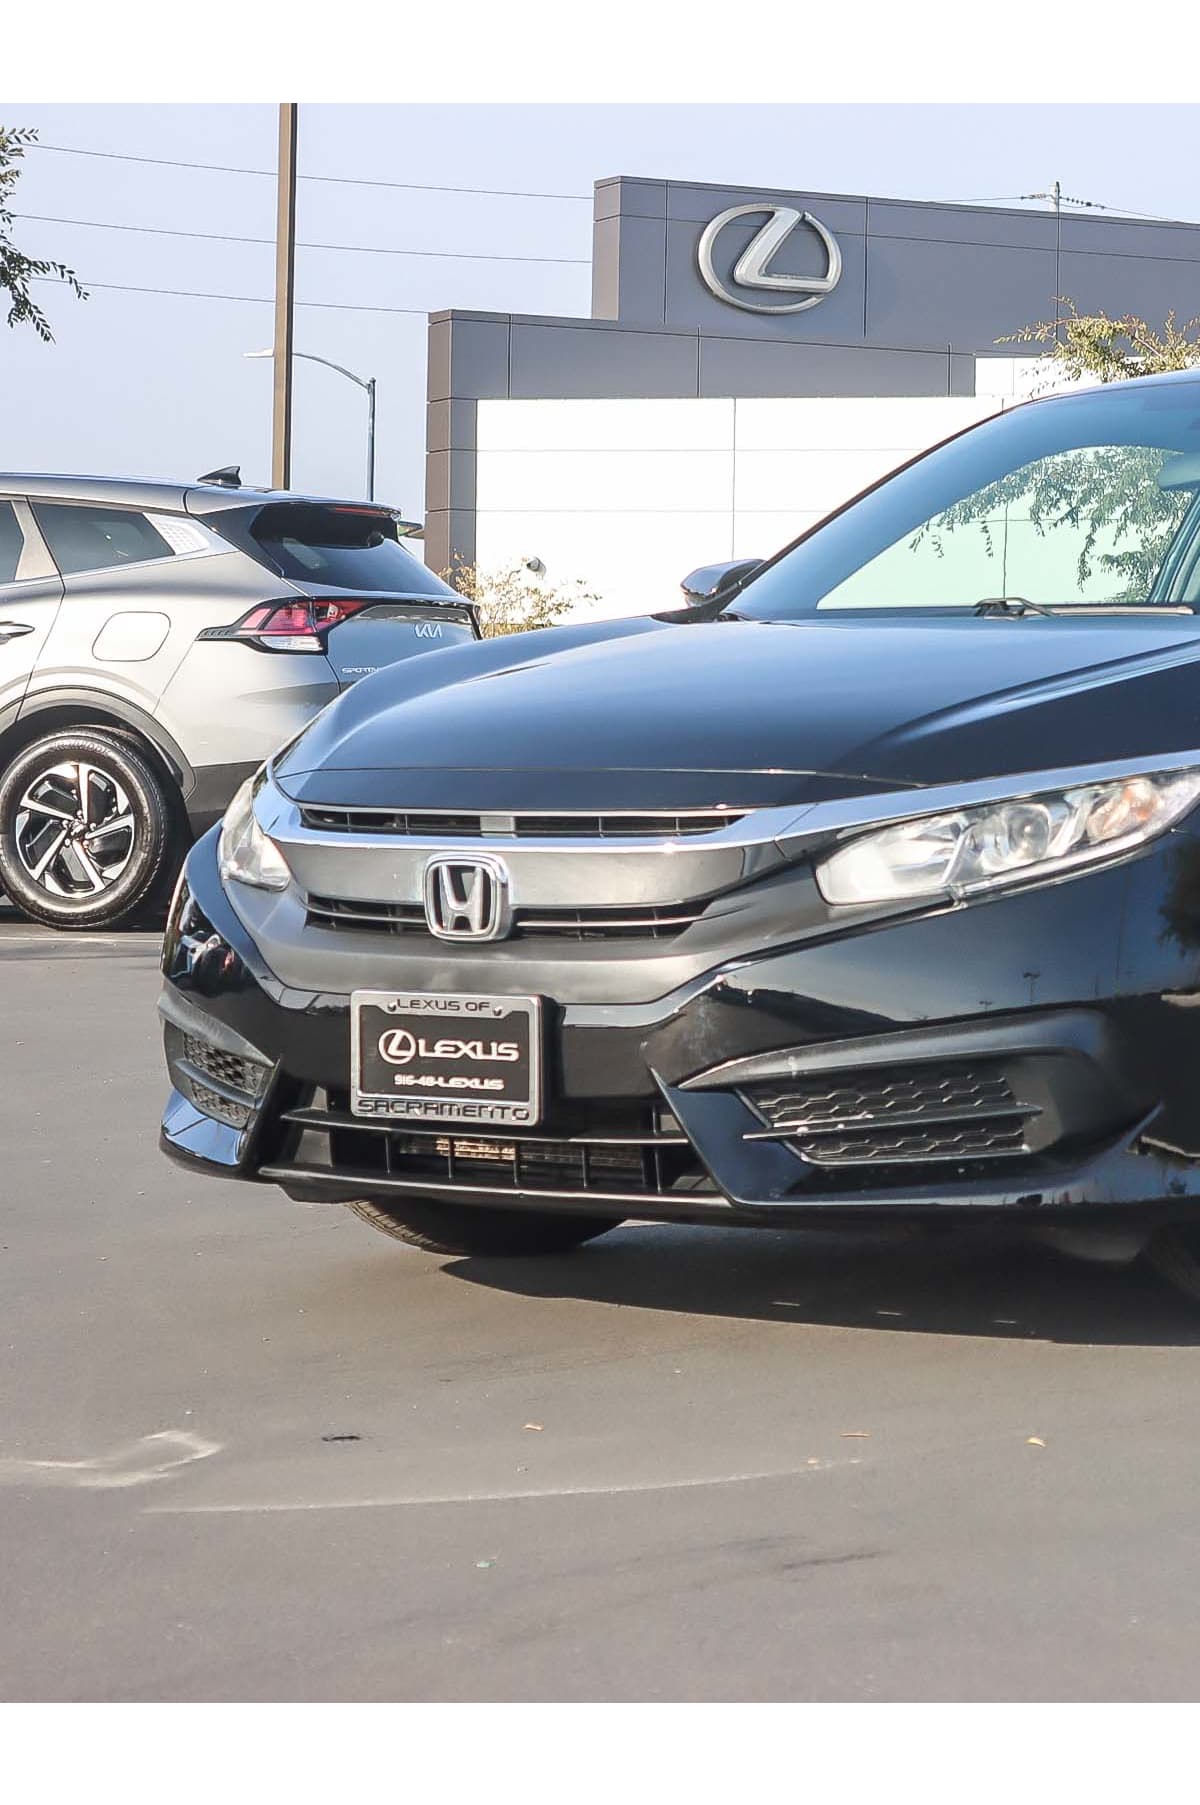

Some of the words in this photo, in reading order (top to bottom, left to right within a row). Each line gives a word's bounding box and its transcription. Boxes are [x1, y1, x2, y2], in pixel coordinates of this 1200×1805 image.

[414, 623, 442, 638] KIA
[397, 998, 460, 1011] LEXUS
[465, 1001, 490, 1012] OF
[418, 1038, 519, 1061] LEXUS
[358, 1100, 529, 1121] SACRAMENTO
